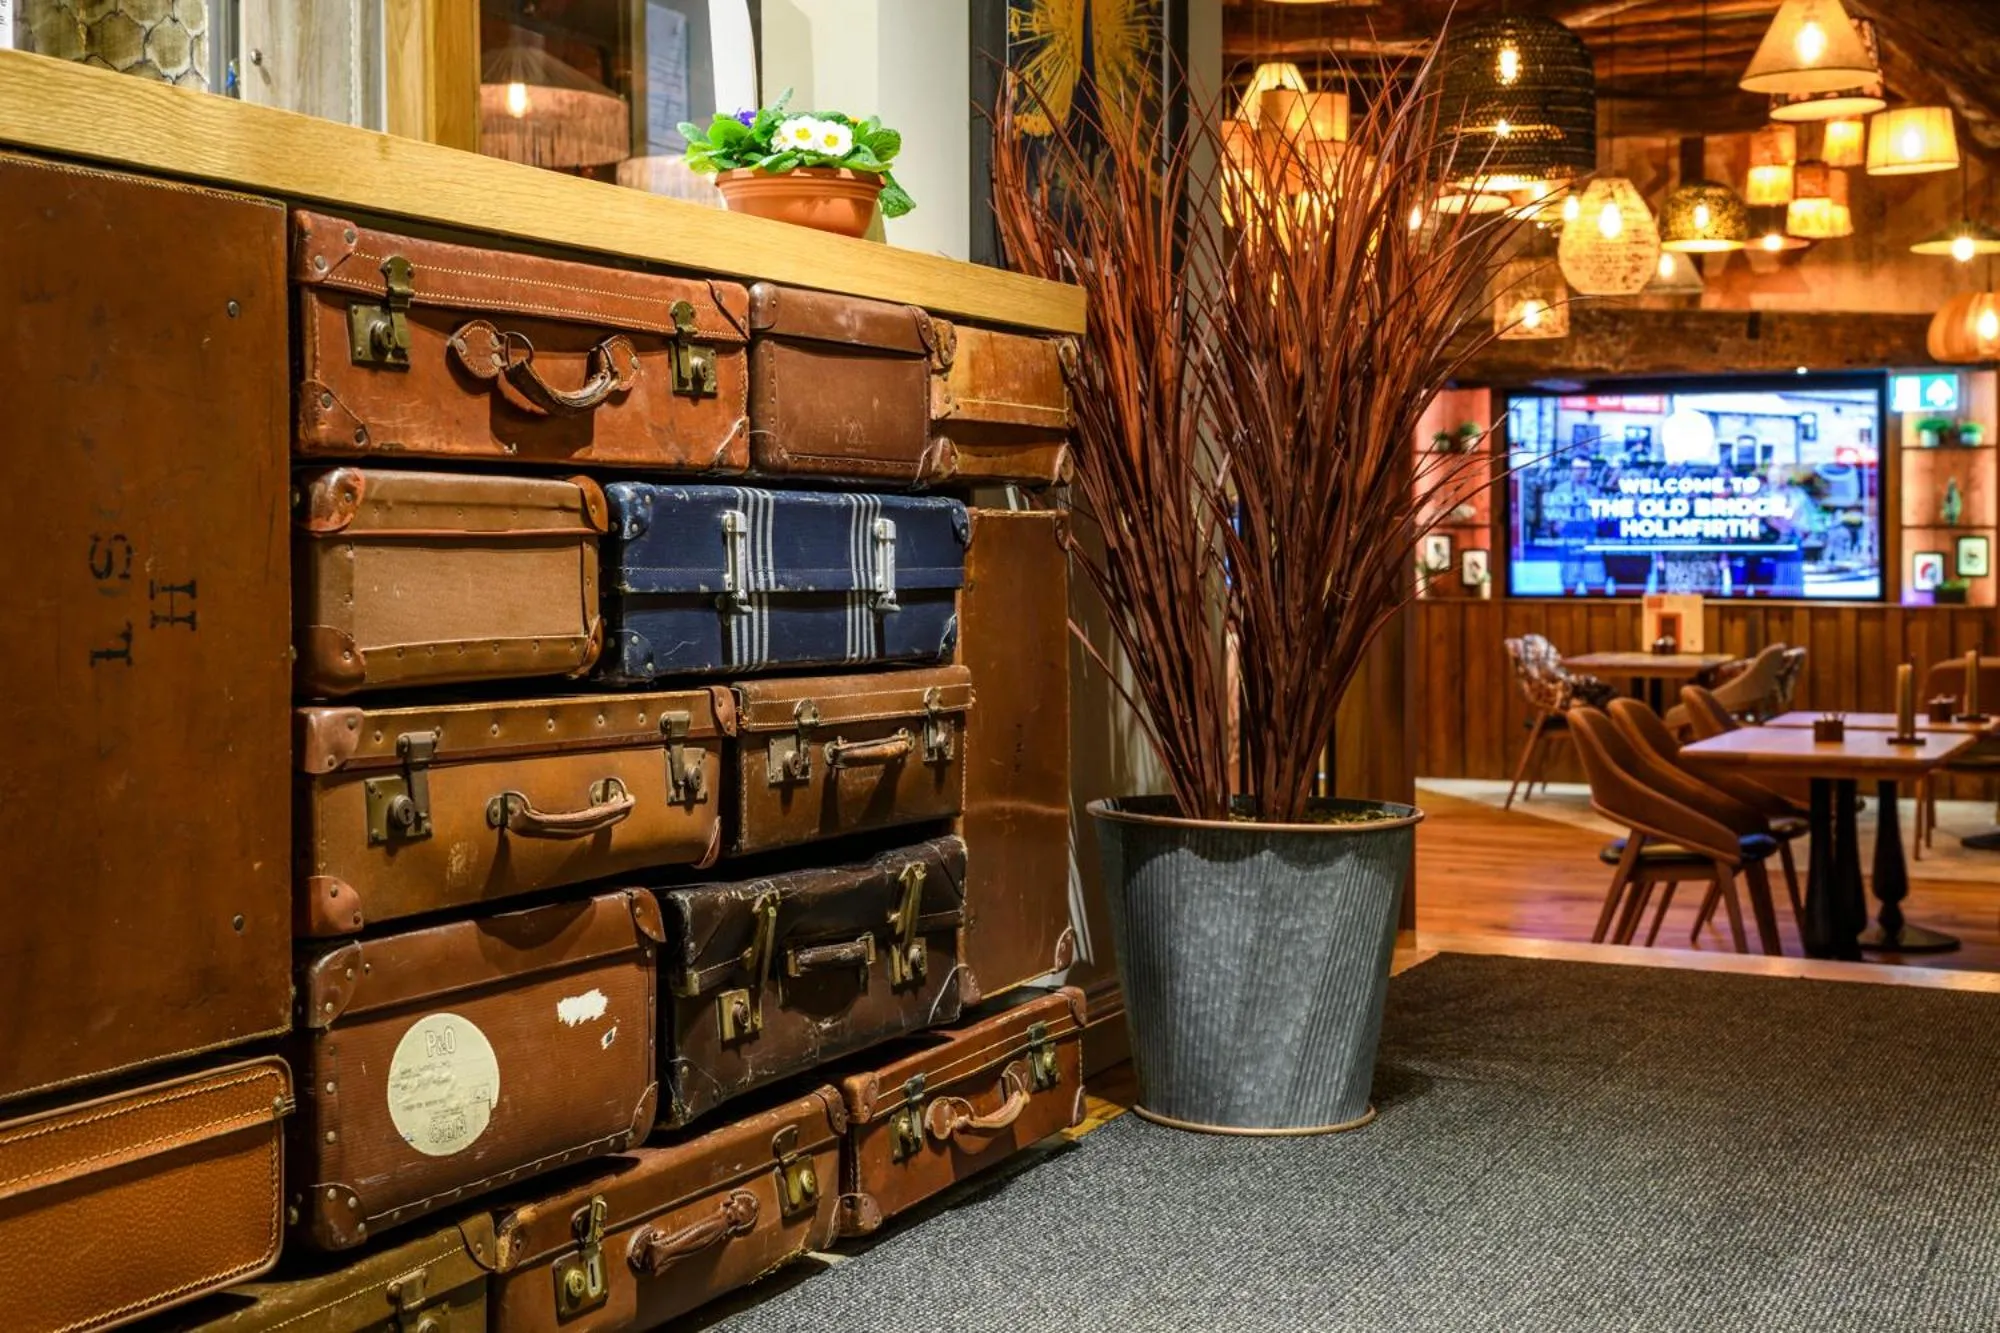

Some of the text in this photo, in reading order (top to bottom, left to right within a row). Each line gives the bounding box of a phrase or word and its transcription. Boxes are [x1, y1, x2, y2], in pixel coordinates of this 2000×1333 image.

[1618, 476, 1761, 494] WELCOME TO
[1589, 498, 1635, 519] THE
[1638, 498, 1690, 518] OLD
[1619, 518, 1760, 538] HOLMFIRTH
[148, 579, 197, 632] H
[424, 1025, 457, 1058] P&O
